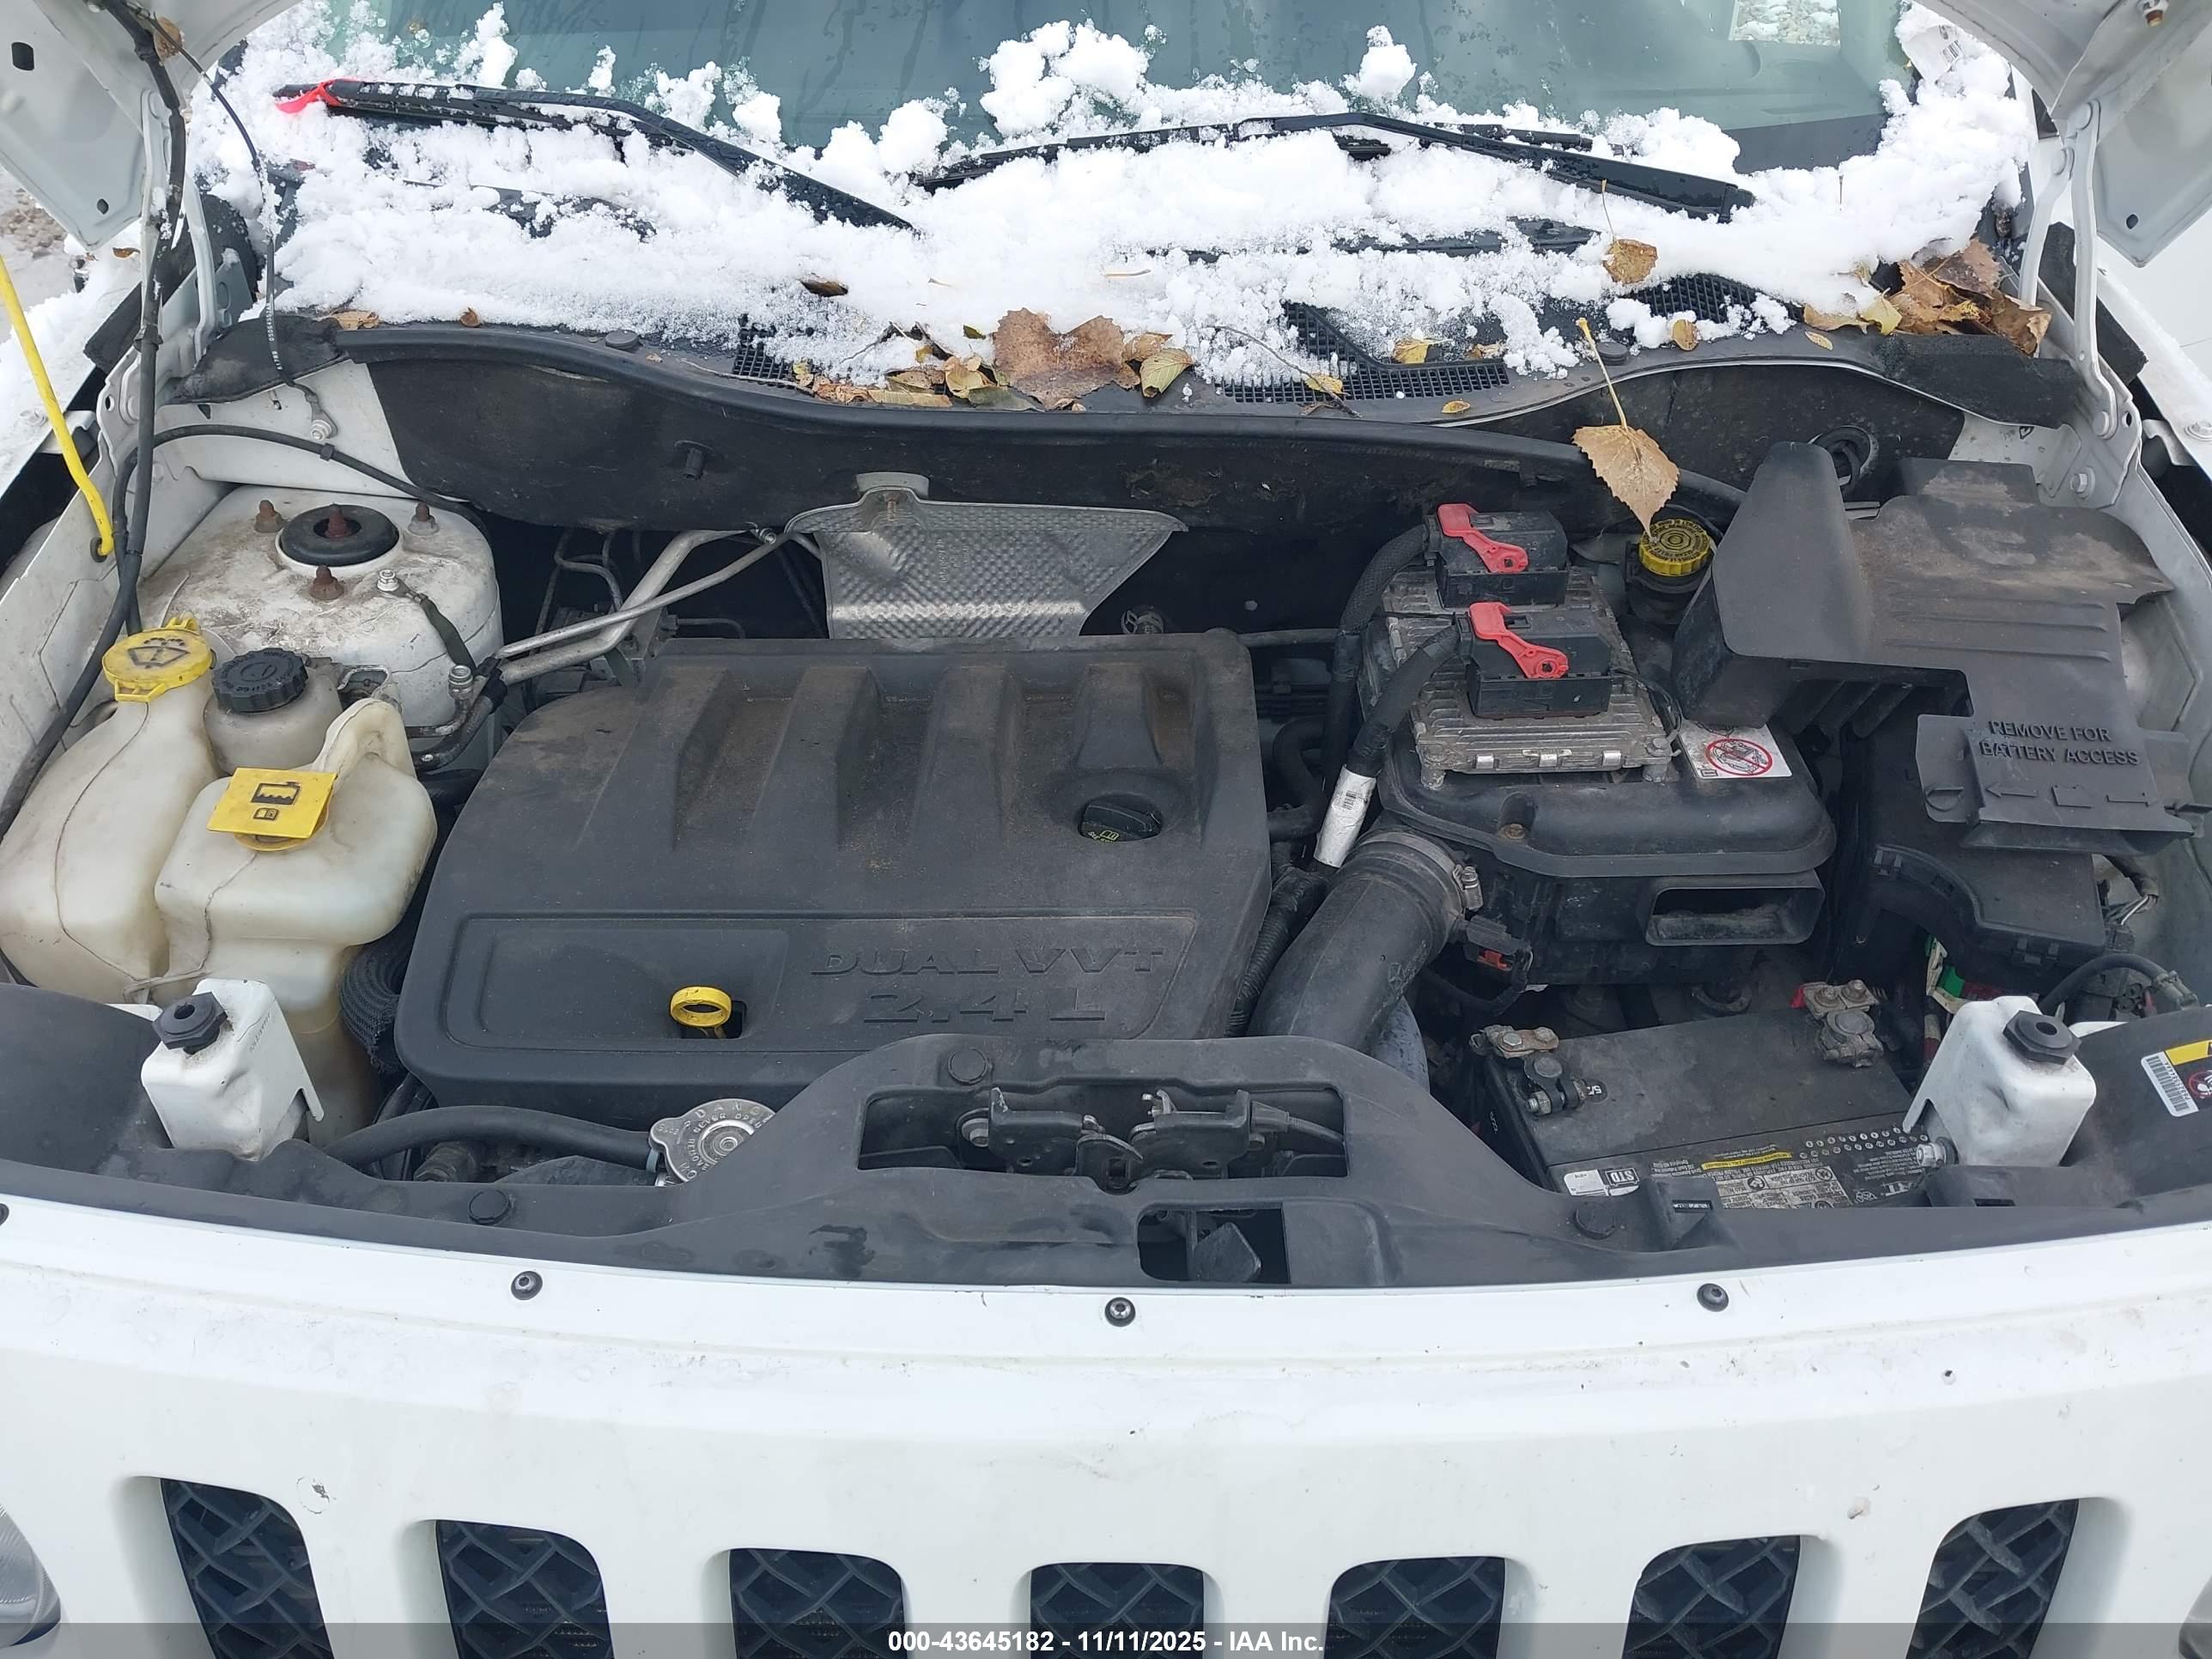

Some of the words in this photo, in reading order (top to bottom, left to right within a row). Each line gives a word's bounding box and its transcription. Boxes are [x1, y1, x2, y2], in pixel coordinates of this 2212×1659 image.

[1988, 720, 2069, 741] REMOVE
[2070, 726, 2112, 743] FOR
[1978, 740, 2057, 763] BATTERY
[2064, 747, 2141, 766] ACCESS
[810, 947, 1000, 975] DUAL
[1016, 946, 1165, 975] VVT
[693, 1113, 727, 1134] NEVER
[1609, 1169, 1635, 1183] STD
